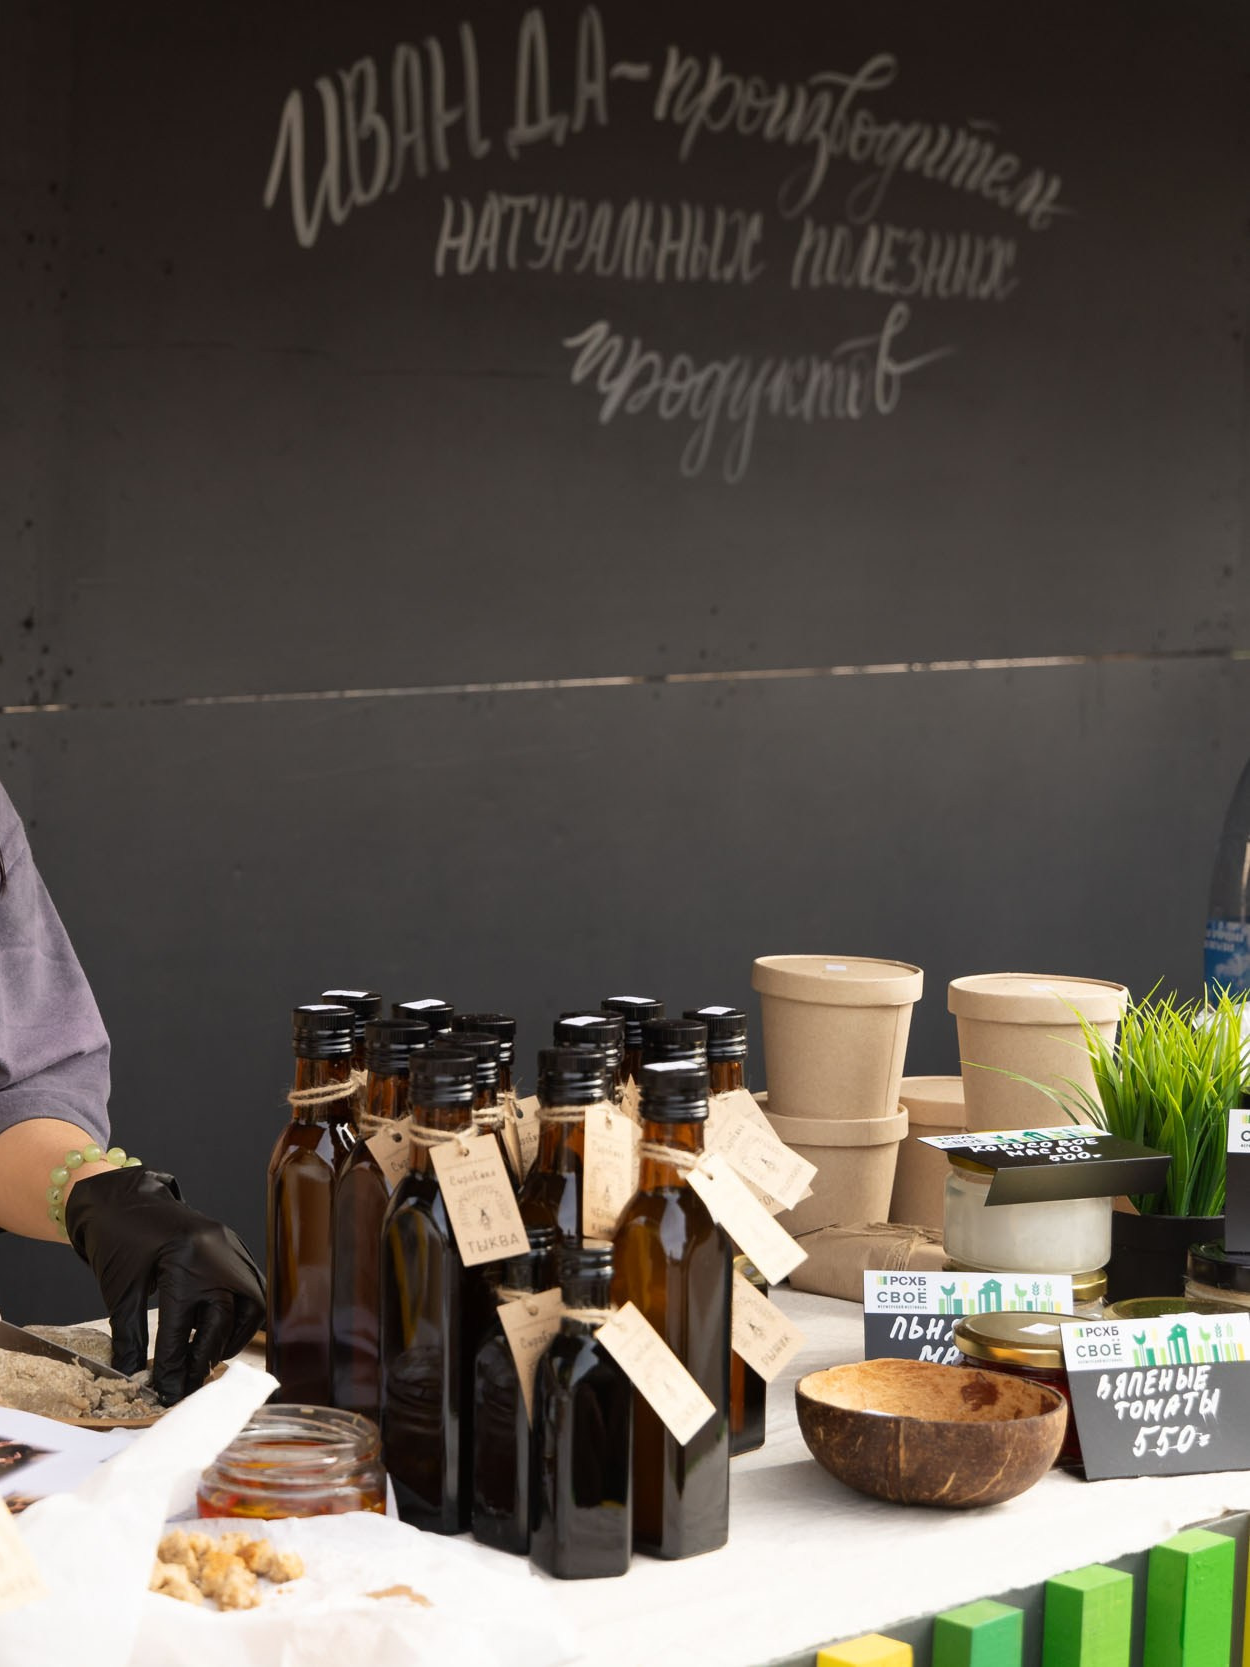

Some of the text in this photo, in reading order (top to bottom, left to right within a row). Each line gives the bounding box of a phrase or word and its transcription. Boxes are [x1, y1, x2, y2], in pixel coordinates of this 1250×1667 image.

[263, 20, 491, 248] ИВАН
[434, 192, 1018, 301] НАТУРАЛЬНЫХ ПОЛЕЗНЫХ
[467, 1232, 521, 1255] ТЫКВА
[889, 1276, 927, 1286] РСХБ
[876, 1287, 927, 1304] СВОЁ
[1085, 1325, 1119, 1338] РСХБ
[1076, 1338, 1122, 1358] СВОЁ
[1096, 1364, 1212, 1401] ВЯЛЕНЫЕ
[1114, 1388, 1222, 1422] ТОМАТЫ
